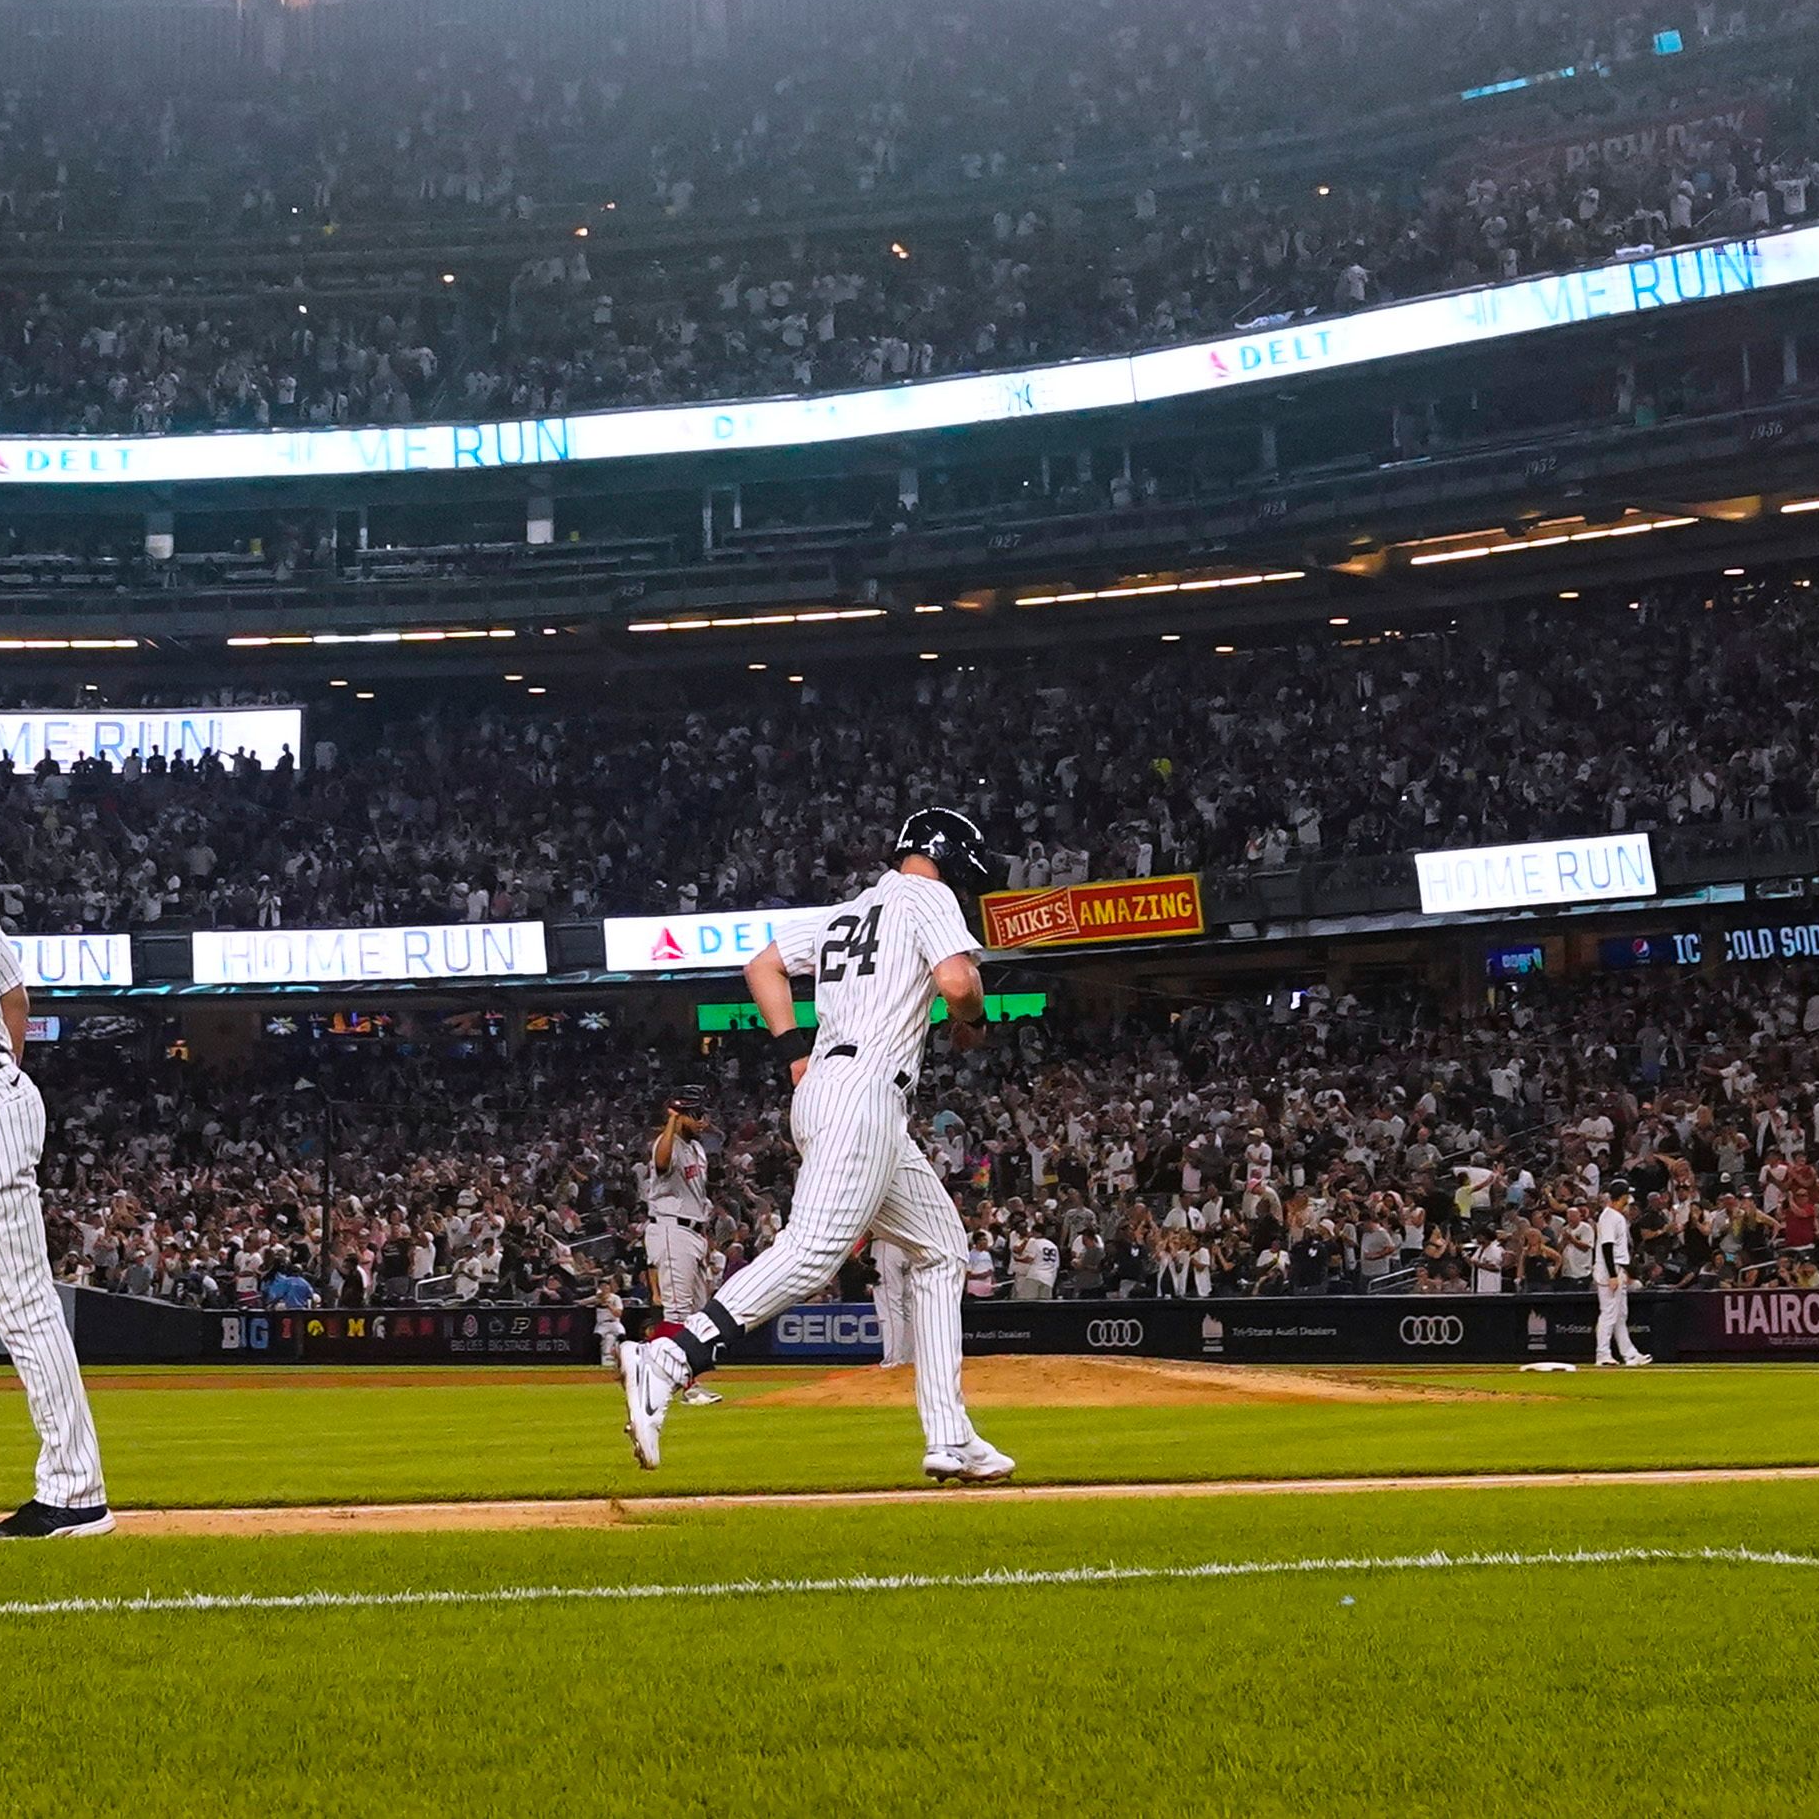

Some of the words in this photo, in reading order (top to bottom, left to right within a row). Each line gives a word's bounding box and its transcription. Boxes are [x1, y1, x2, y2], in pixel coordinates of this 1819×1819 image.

[1631, 242, 1759, 311] RUN
[1241, 330, 1337, 372] DELT
[25, 448, 135, 472] DELT
[454, 419, 568, 469] RUN
[94, 720, 215, 764] RUN
[1425, 854, 1543, 902] HOME
[1556, 844, 1646, 892] RUN
[1004, 901, 1067, 939] MIKE'S
[1081, 892, 1193, 926] AMAZING
[15, 929, 111, 983] UN
[222, 932, 383, 978] HOME
[403, 927, 515, 974] RUN
[819, 904, 882, 984] 24
[1673, 933, 1702, 964] IC
[777, 1314, 884, 1344] GEICO
